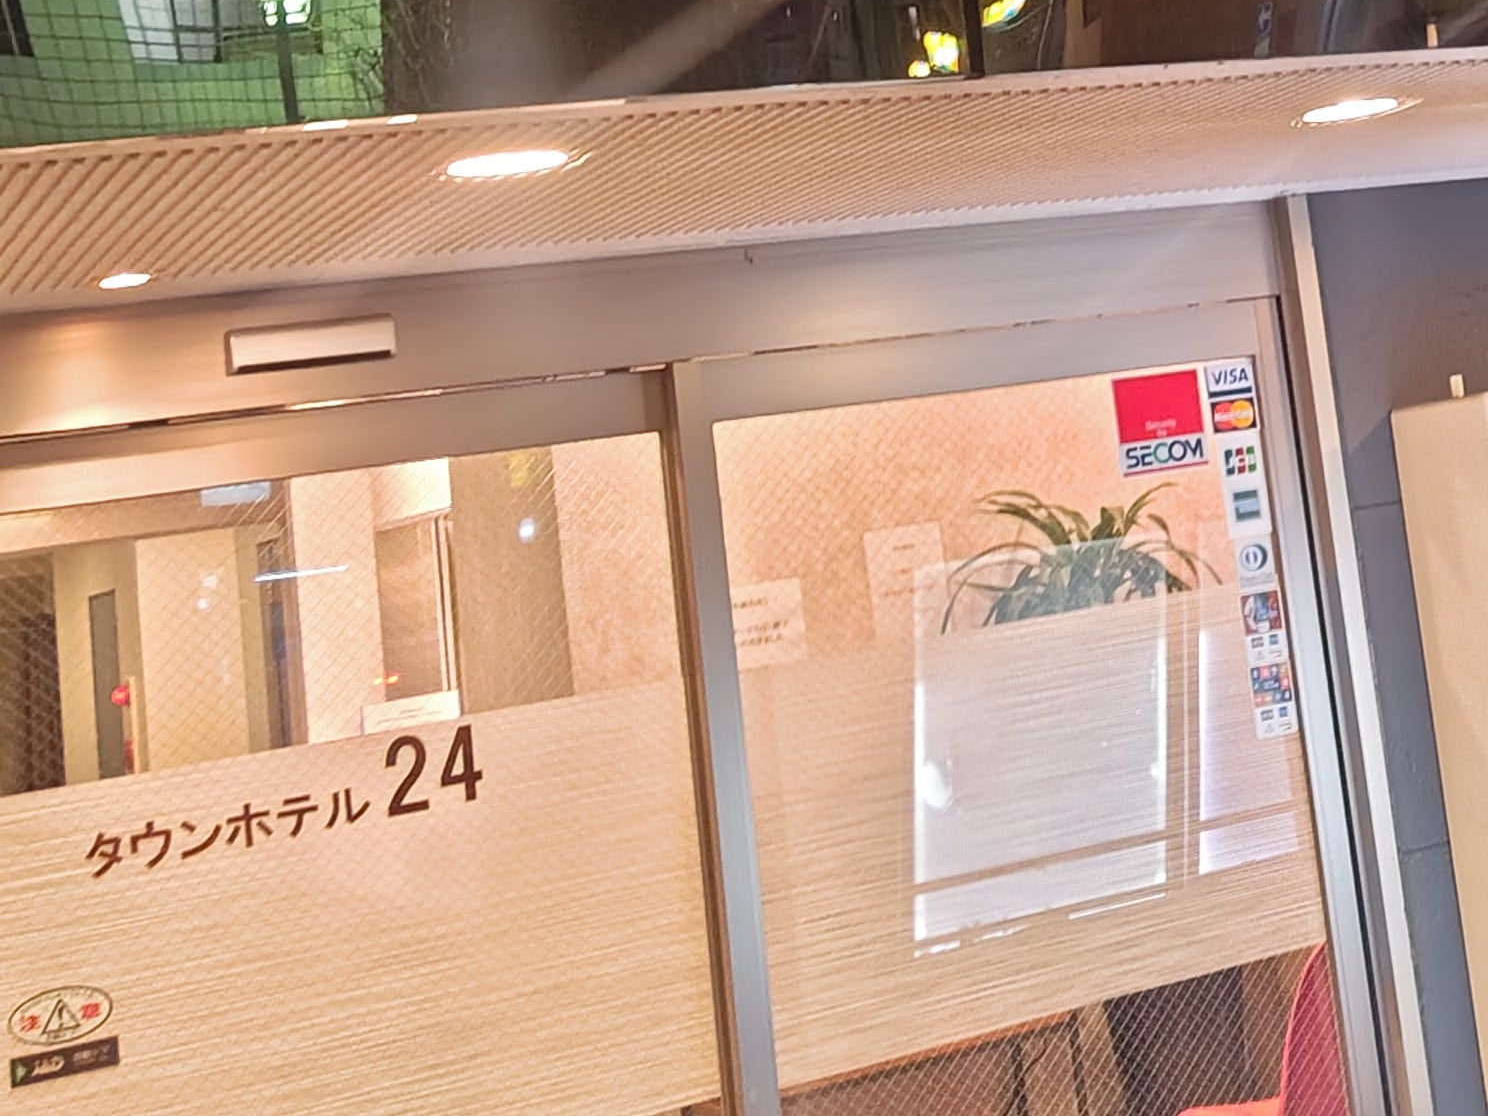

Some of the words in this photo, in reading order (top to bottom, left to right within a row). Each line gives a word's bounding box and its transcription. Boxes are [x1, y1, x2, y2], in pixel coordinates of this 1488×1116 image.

[1211, 367, 1249, 386] VISA
[1125, 438, 1204, 470] SECOM
[85, 787, 371, 879] タウンホテル
[384, 723, 484, 818] 24
